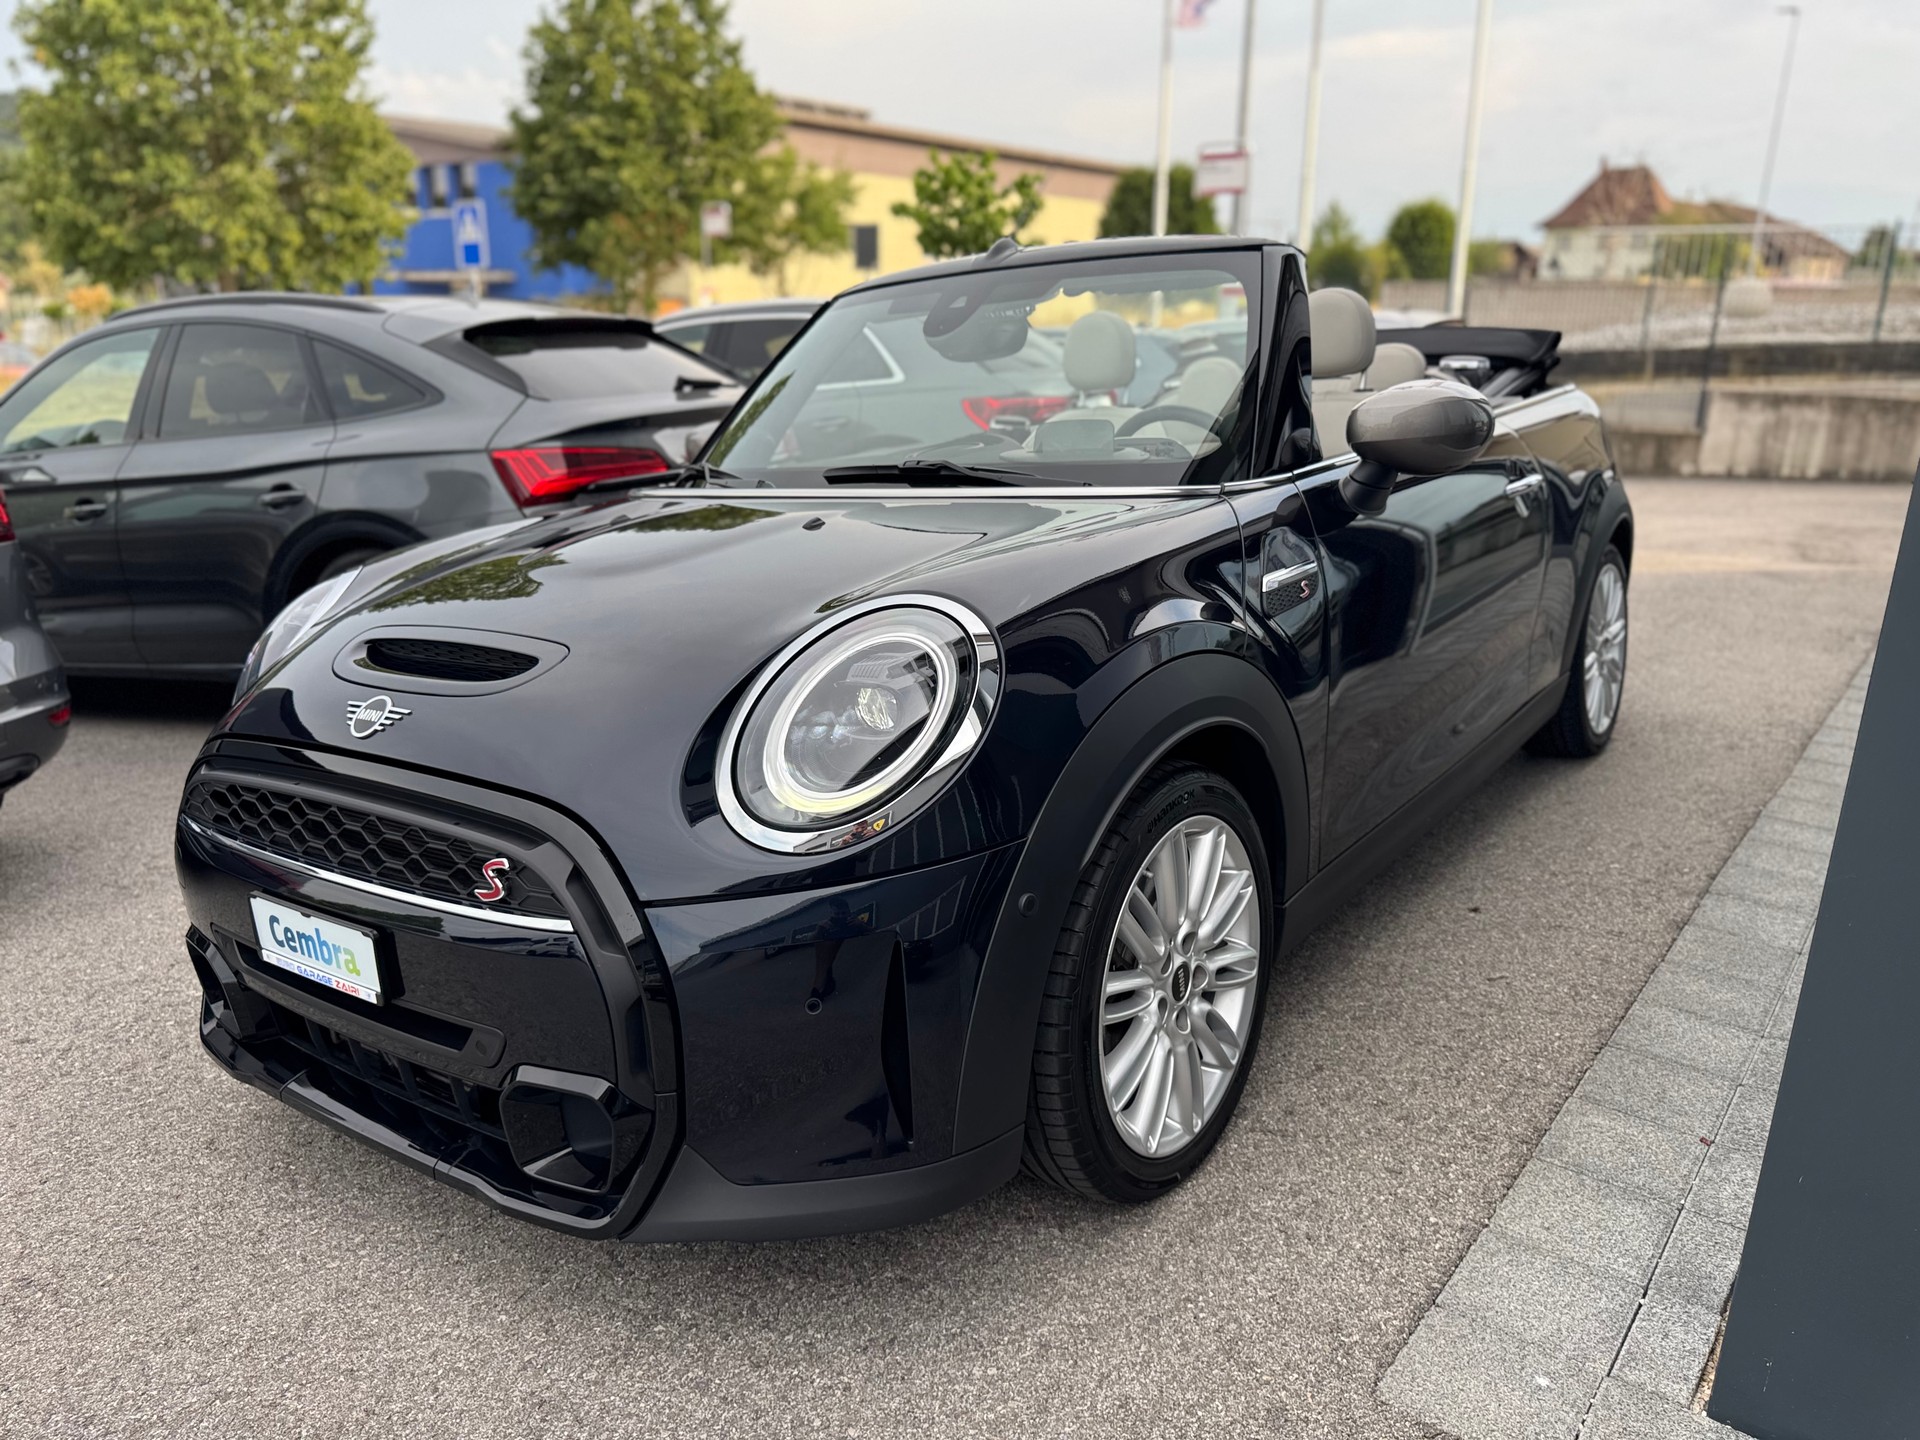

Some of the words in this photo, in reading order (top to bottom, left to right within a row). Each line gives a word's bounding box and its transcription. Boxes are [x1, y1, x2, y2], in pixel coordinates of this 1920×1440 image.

[1300, 580, 1310, 598] S
[357, 708, 383, 723] MINI
[474, 857, 510, 901] S
[268, 914, 362, 977] Cembra
[296, 965, 334, 986] GARAGE
[334, 979, 361, 996] ZAIRI
[1177, 968, 1186, 998] MINI
